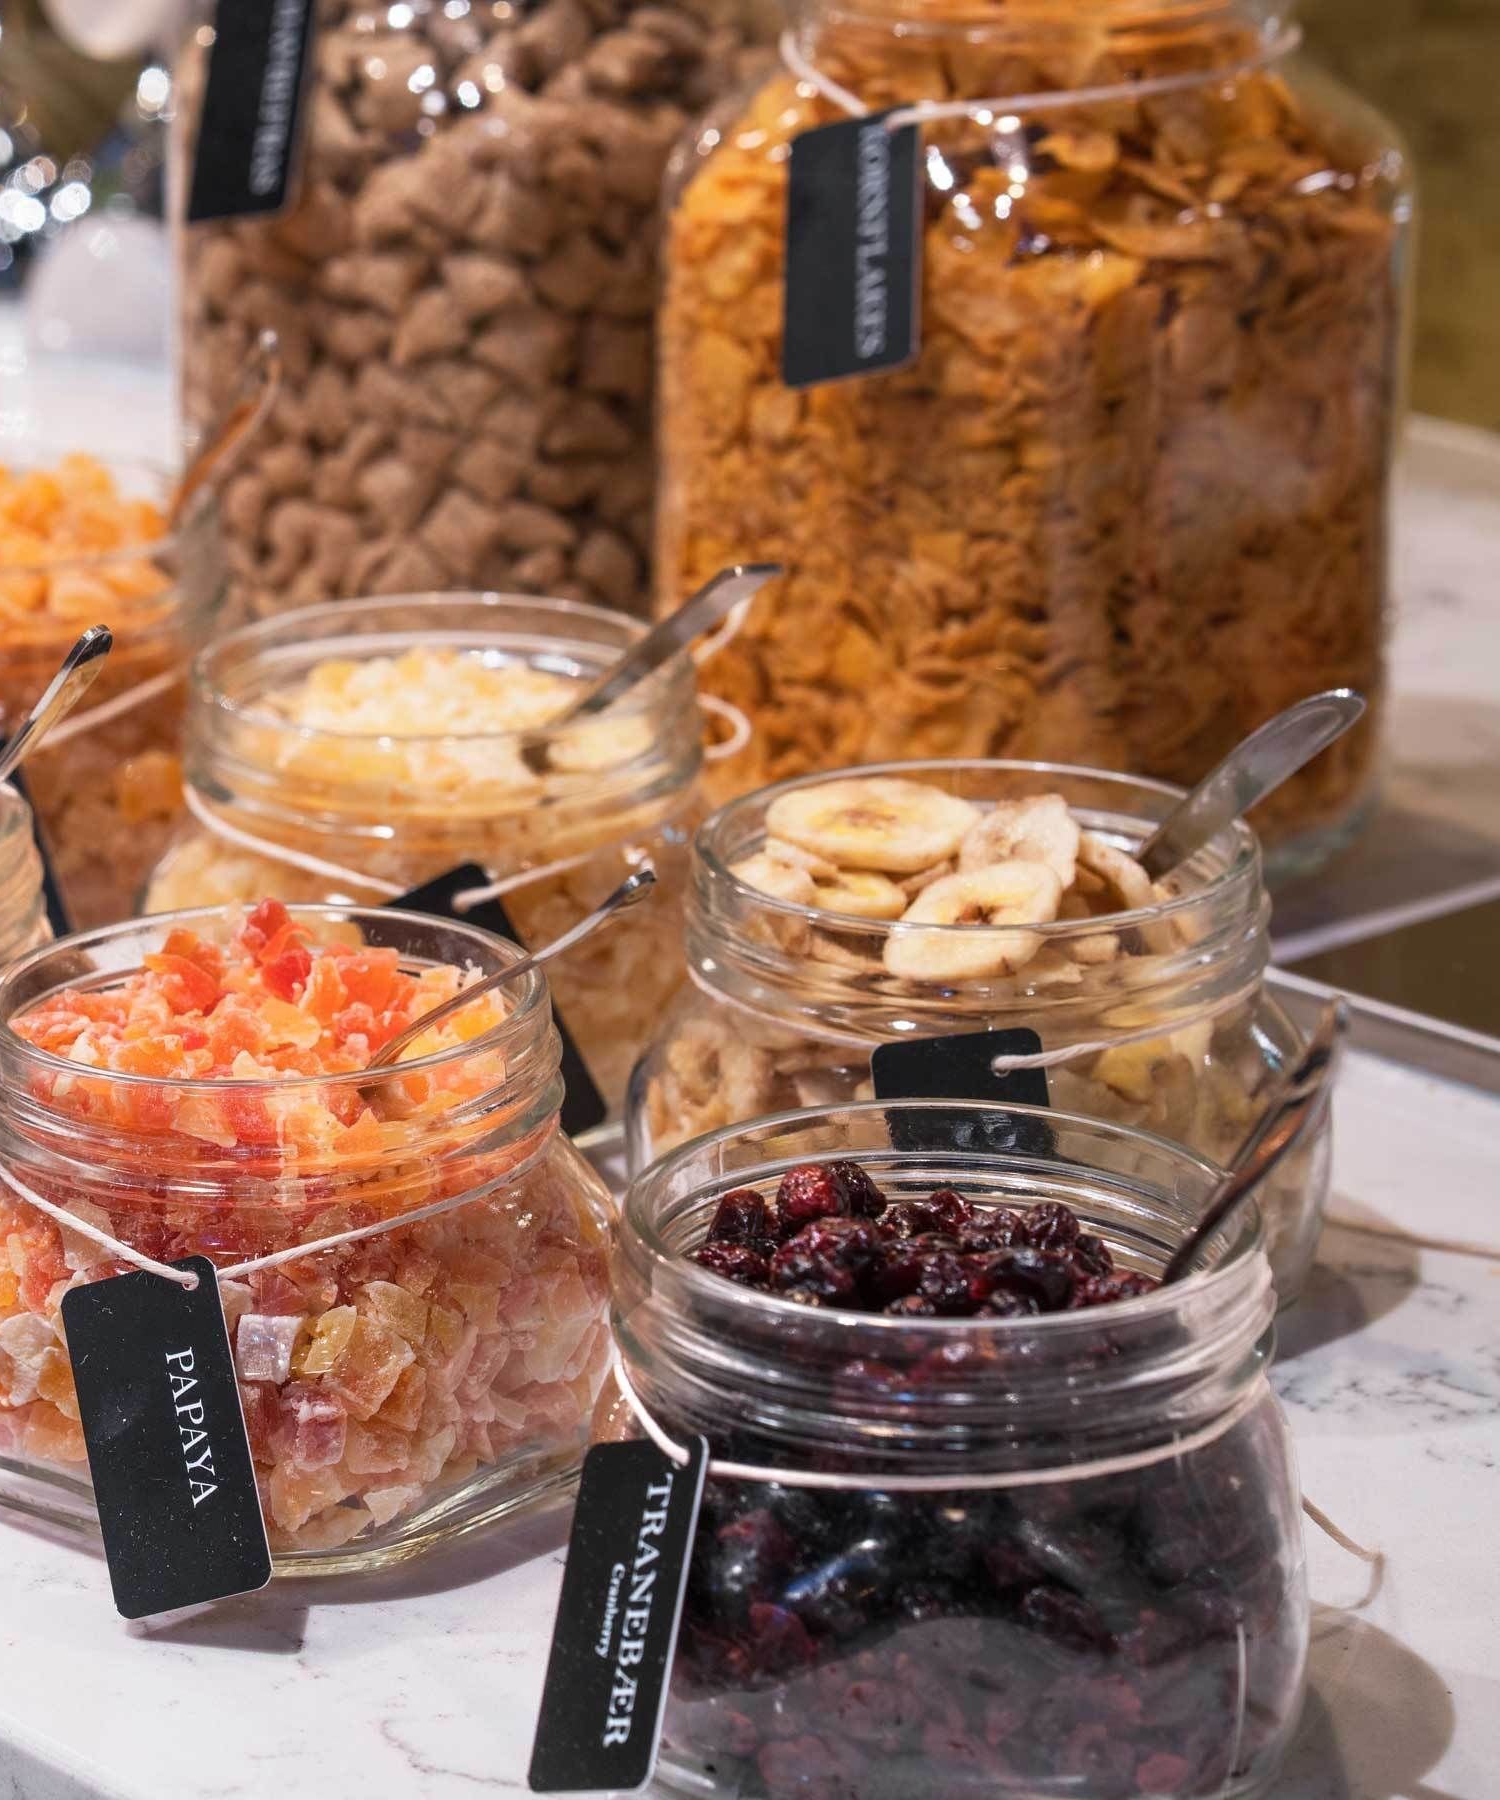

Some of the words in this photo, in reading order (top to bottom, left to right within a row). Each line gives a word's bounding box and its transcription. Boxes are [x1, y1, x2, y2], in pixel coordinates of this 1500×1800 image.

[165, 1346, 219, 1508] PAPAYA
[595, 1562, 626, 1659] Cranberry
[602, 1472, 674, 1748] TRANEBÆR
